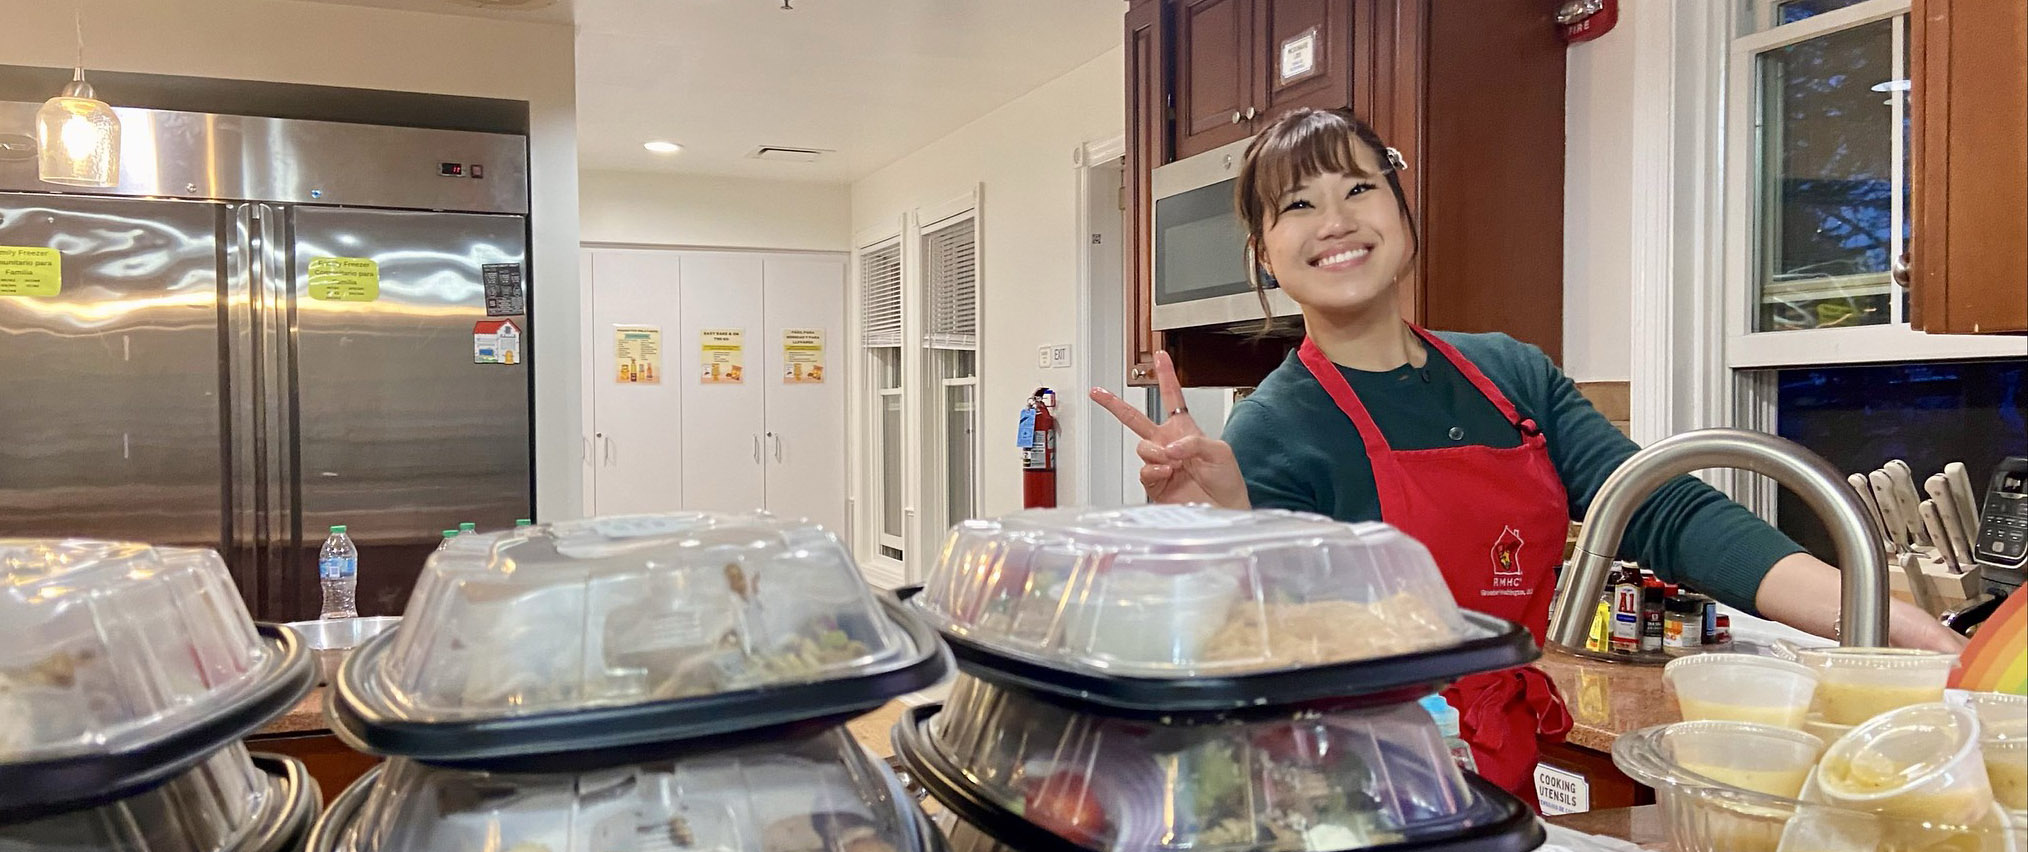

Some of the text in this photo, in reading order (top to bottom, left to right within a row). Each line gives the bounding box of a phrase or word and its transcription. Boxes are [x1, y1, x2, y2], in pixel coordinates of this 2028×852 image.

[1568, 20, 1590, 35] FIRE
[1055, 348, 1065, 360] EXIT
[1540, 773, 1576, 794] COOKING
[1540, 786, 1576, 806] UTENSILS
